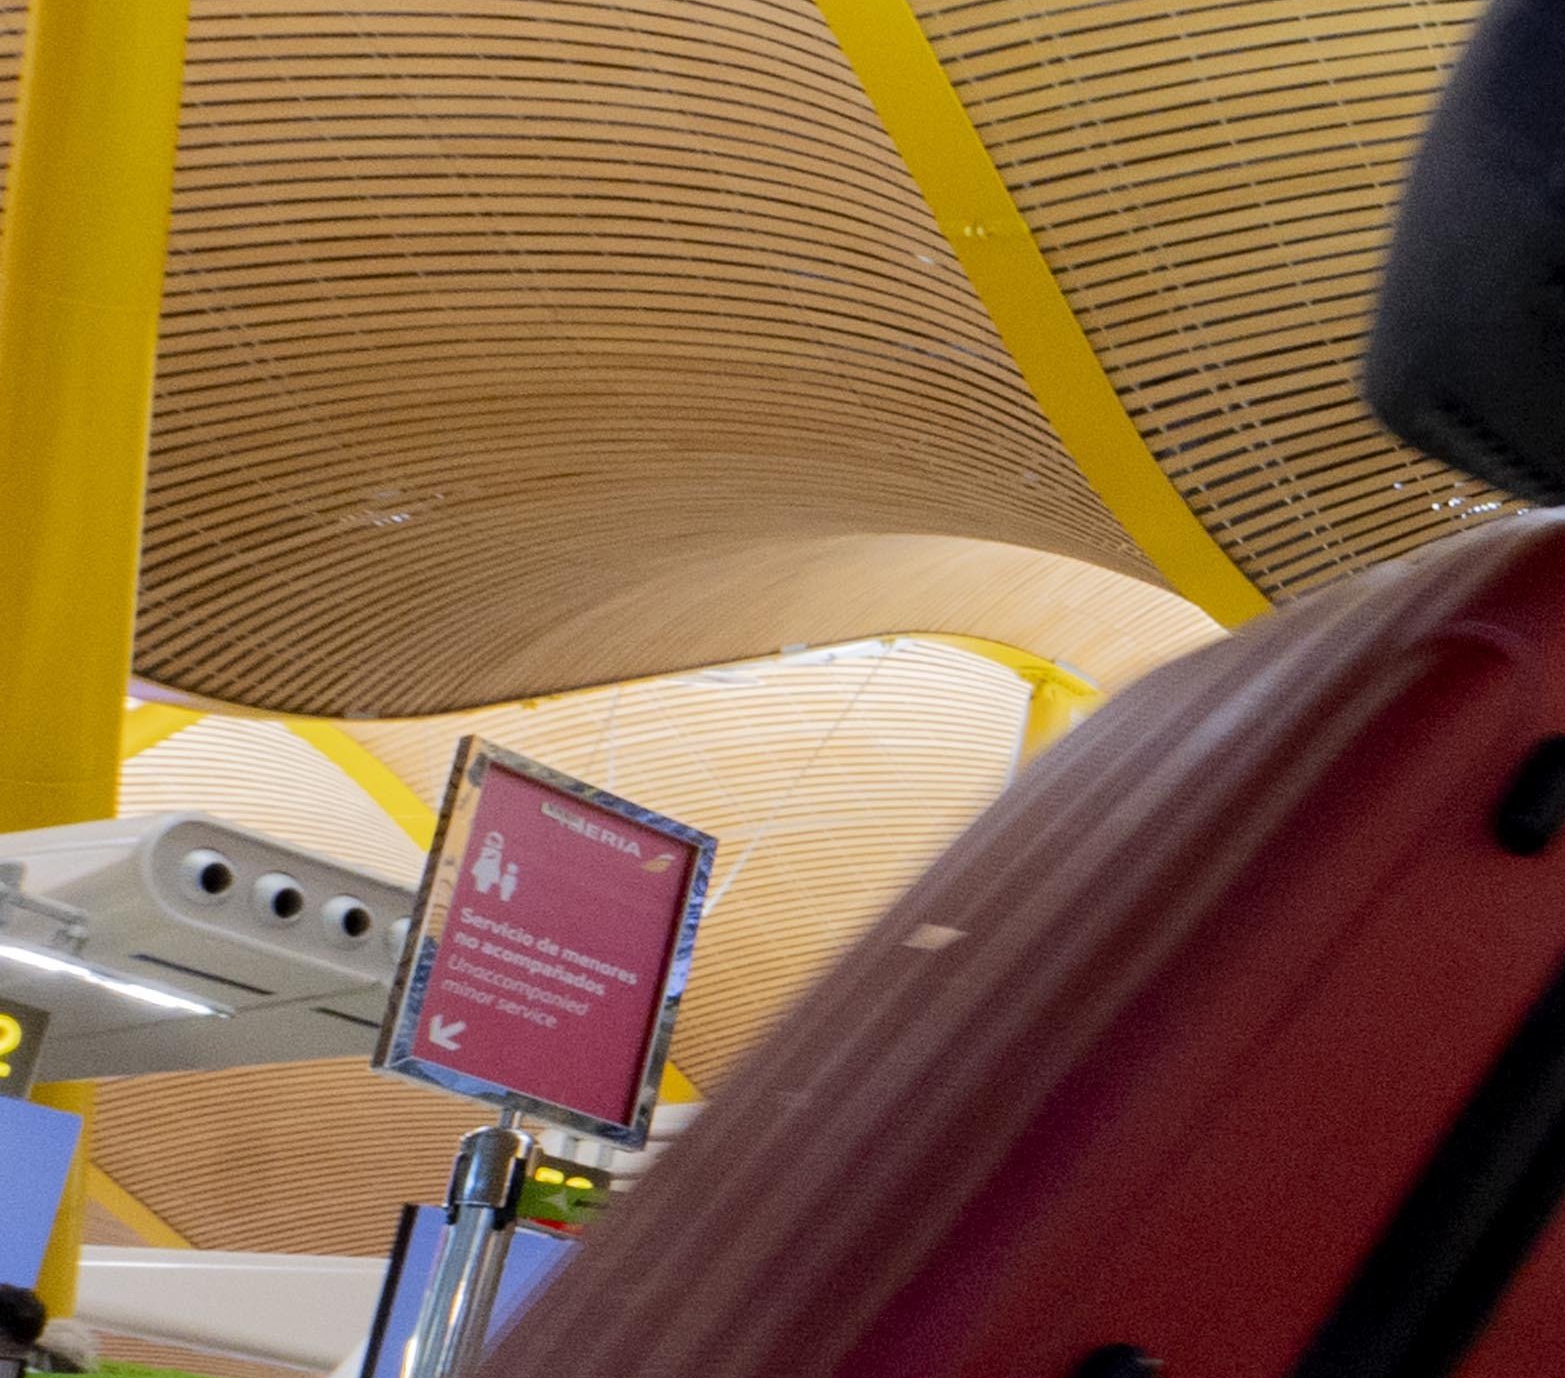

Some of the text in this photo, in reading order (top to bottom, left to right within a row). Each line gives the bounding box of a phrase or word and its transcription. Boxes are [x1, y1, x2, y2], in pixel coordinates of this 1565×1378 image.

[454, 932, 606, 997] no acompañados
[460, 907, 638, 986] Servicio de menores
[441, 979, 558, 1029] minor service
[447, 954, 590, 1016] Unaccompanied
